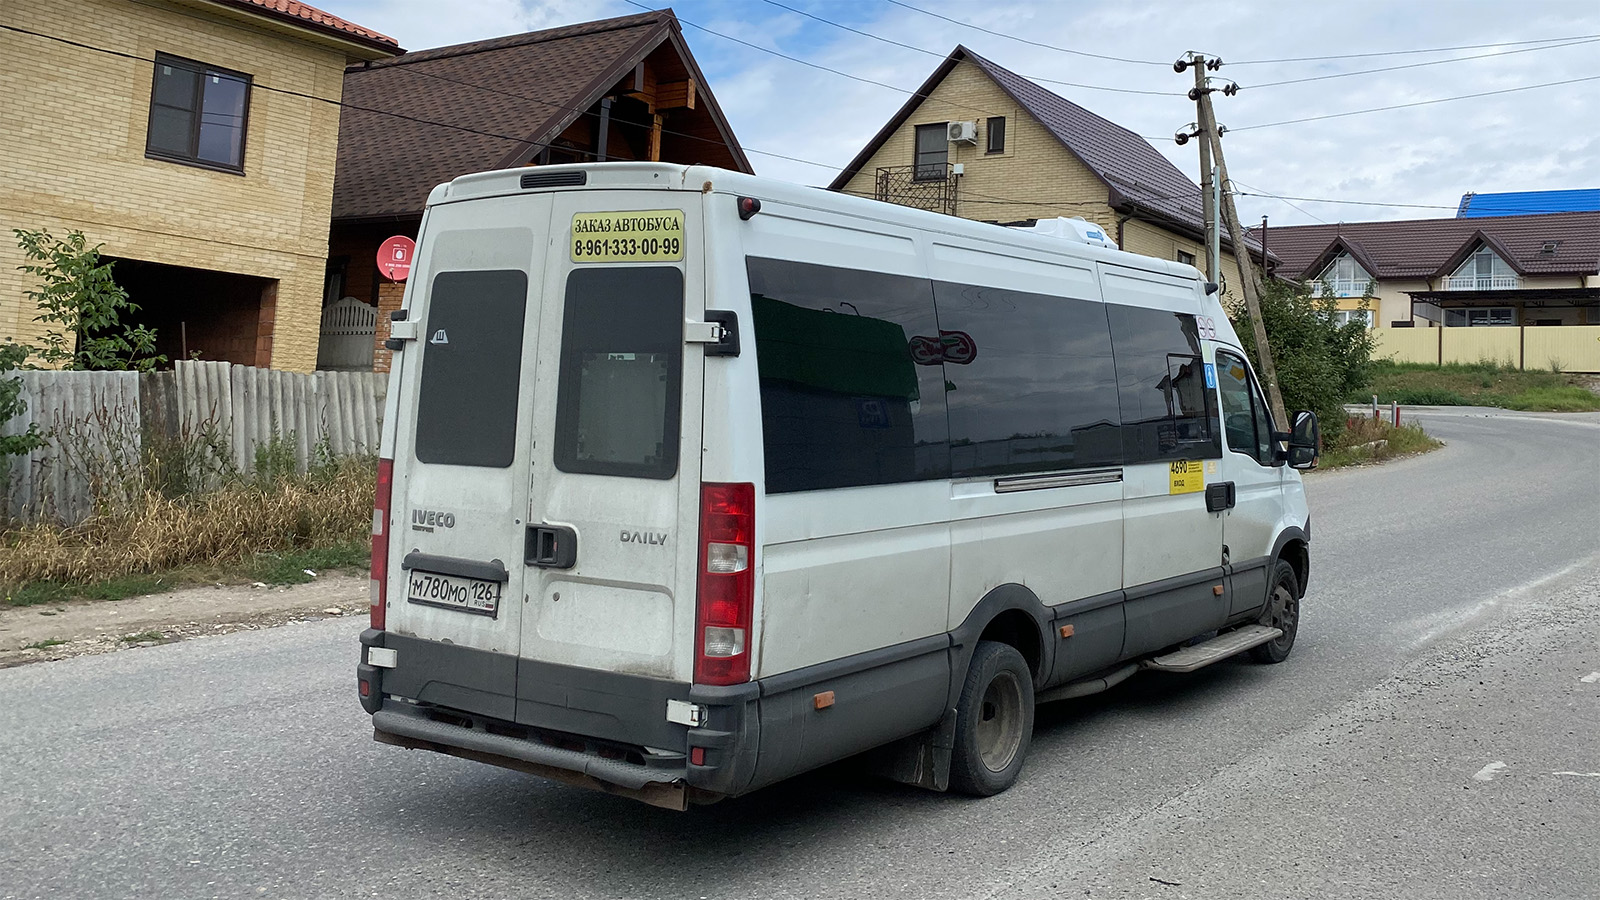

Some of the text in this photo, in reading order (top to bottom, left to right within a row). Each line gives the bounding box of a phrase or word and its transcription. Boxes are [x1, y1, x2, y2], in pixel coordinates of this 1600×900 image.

[575, 217, 680, 233] ЗАКАЗ АВТОБУСА
[574, 238, 680, 256] 8-961-333-00-99
[1171, 461, 1188, 474] 4690
[412, 509, 456, 529] IVECO
[620, 530, 667, 546] DAILY
[412, 576, 493, 603] М780МО 126
[474, 600, 486, 608] RUS
